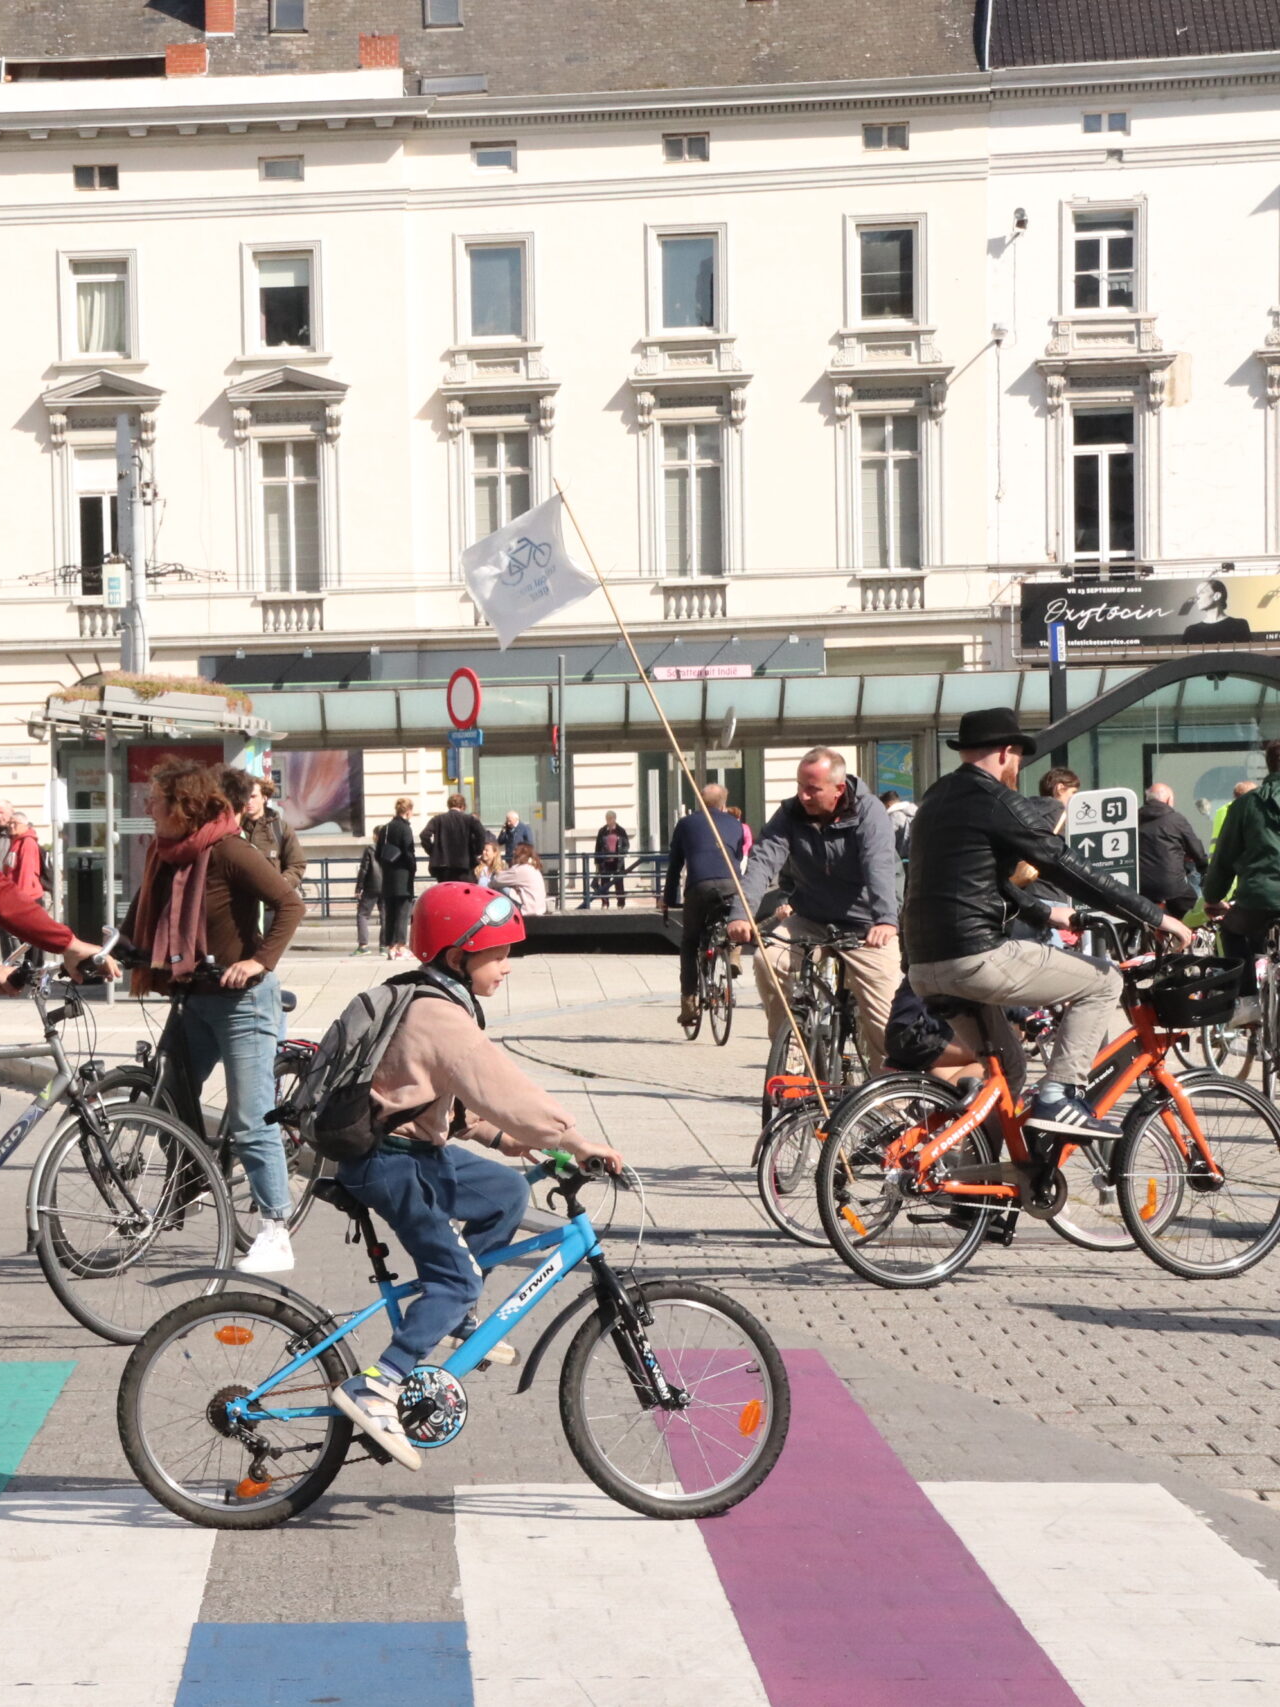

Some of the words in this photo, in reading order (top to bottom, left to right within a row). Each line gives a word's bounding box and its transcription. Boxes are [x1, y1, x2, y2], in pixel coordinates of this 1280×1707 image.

[1086, 586, 1125, 594] SEPTEMBER
[1043, 598, 1173, 630] Oxytocin
[1105, 801, 1122, 818] 51
[1111, 838, 1120, 852] 2
